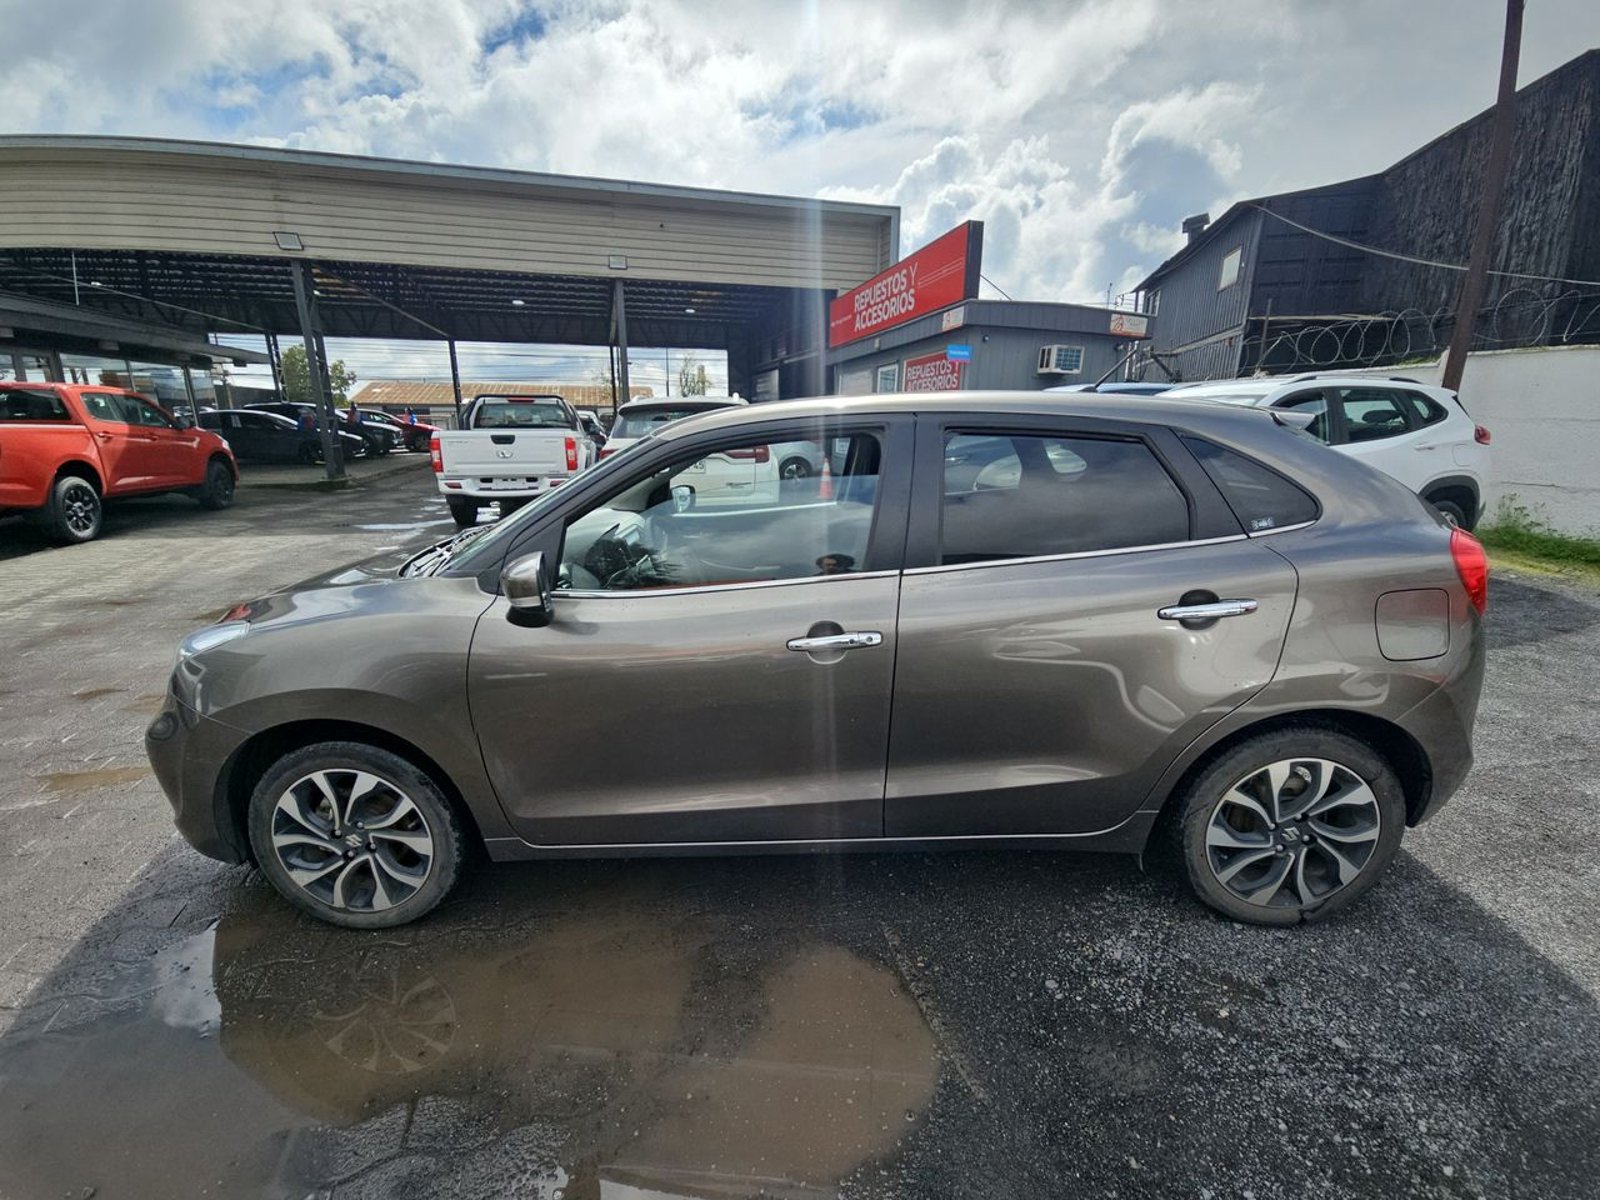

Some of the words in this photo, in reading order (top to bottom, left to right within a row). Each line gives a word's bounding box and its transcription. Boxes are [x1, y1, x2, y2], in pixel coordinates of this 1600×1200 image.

[854, 269, 907, 313] REPUESTOS
[909, 262, 919, 286] Y
[854, 288, 916, 333] ACCESORIOS
[907, 360, 952, 379] REPUESTOS
[907, 373, 959, 392] ACCESORIOS
